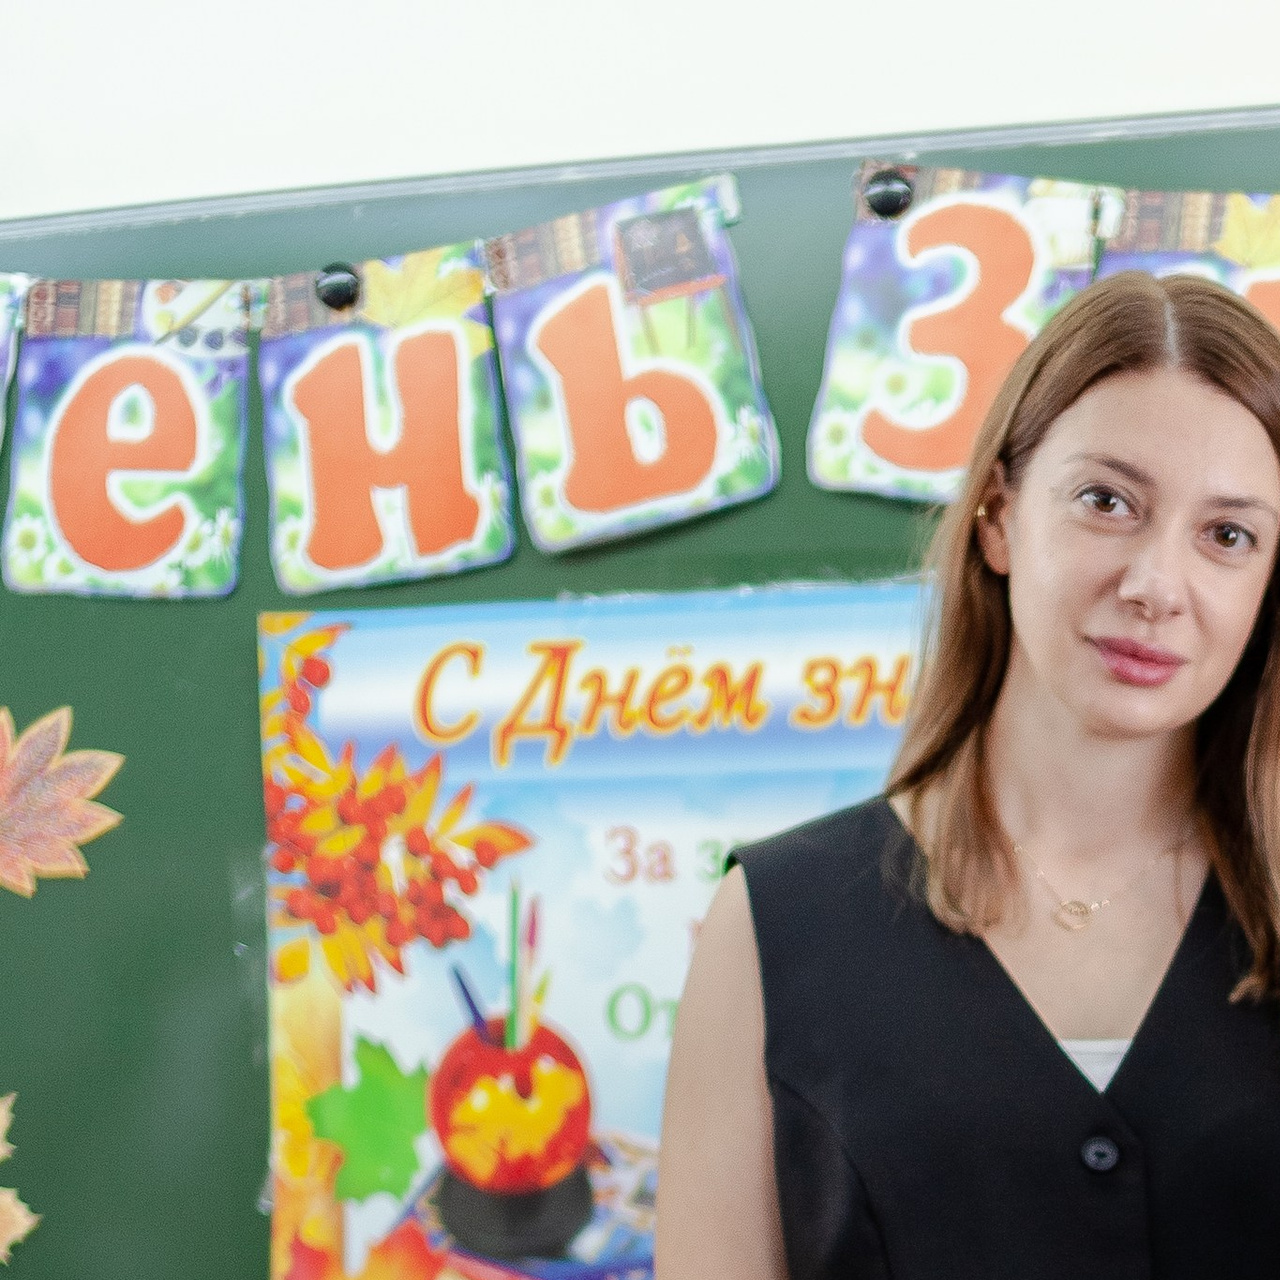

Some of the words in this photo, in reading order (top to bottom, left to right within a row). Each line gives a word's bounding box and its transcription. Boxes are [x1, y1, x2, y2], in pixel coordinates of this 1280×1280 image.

[417, 641, 482, 744] С
[493, 639, 768, 766] Днём
[604, 824, 676, 884] За
